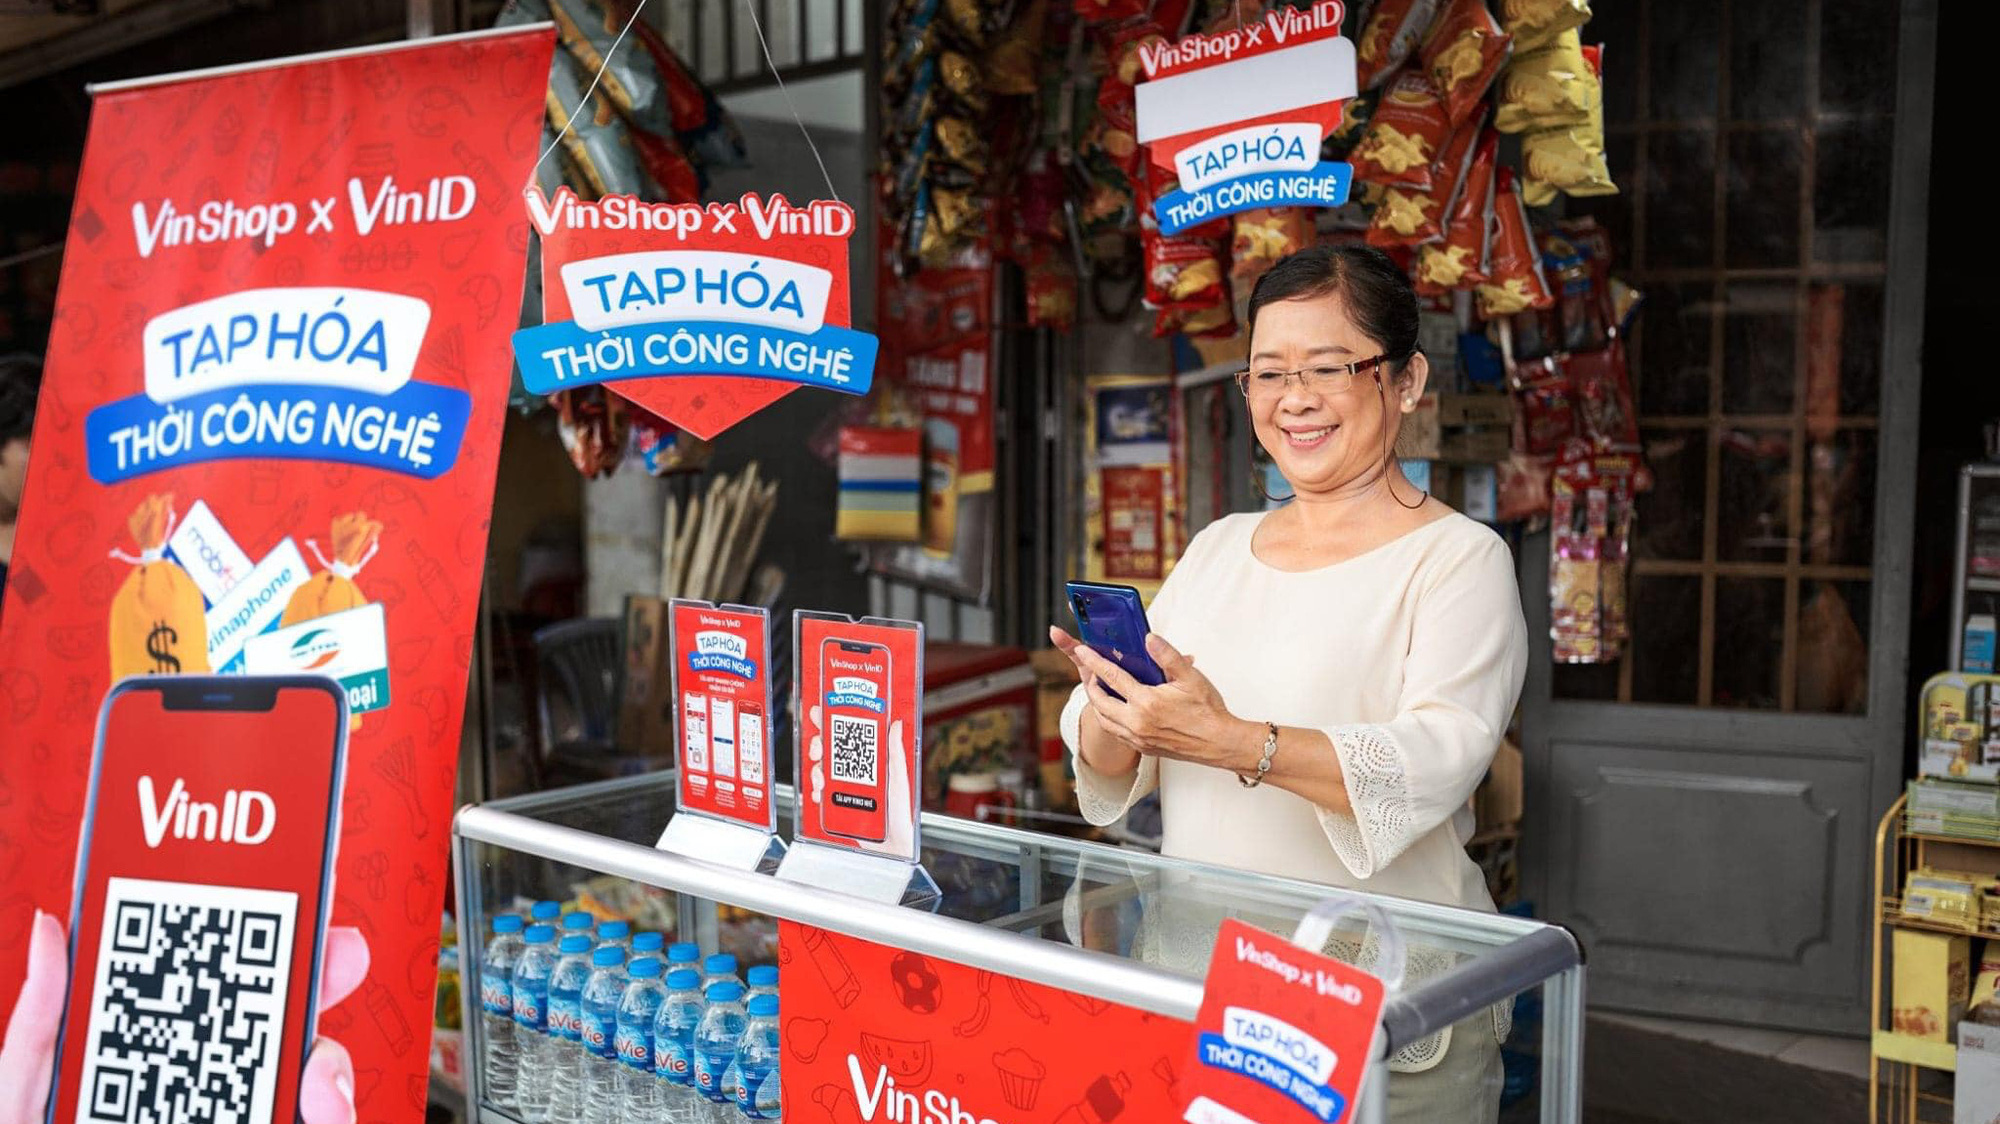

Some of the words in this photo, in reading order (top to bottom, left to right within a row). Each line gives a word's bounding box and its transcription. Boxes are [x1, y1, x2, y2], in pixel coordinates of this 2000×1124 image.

[1139, 32, 1240, 76] VinShop
[1245, 25, 1262, 48] x
[1266, 1, 1341, 43] VinID
[1243, 128, 1305, 163] HÓA
[132, 198, 297, 258] VinShop
[305, 197, 336, 235] x
[347, 175, 476, 236] VinID
[527, 191, 702, 240] VinShop
[711, 207, 737, 233] x
[746, 196, 851, 240] VinID
[1166, 192, 1213, 227] THỜI
[1216, 181, 1274, 210] CÔNG
[1278, 175, 1337, 203] NGHỆ
[583, 268, 686, 313] TẠP
[695, 261, 804, 318] HÓA
[266, 296, 388, 372] HÓA
[541, 331, 635, 380] THỜI
[643, 328, 749, 366] CÔNG
[758, 337, 854, 385] NGHỆ
[109, 404, 194, 470] THỜI
[201, 393, 316, 447] CÔNG
[321, 403, 442, 469] NGHỆ
[346, 676, 378, 710] oại
[137, 775, 277, 848] VinID
[846, 1053, 1000, 1124] VinSh
